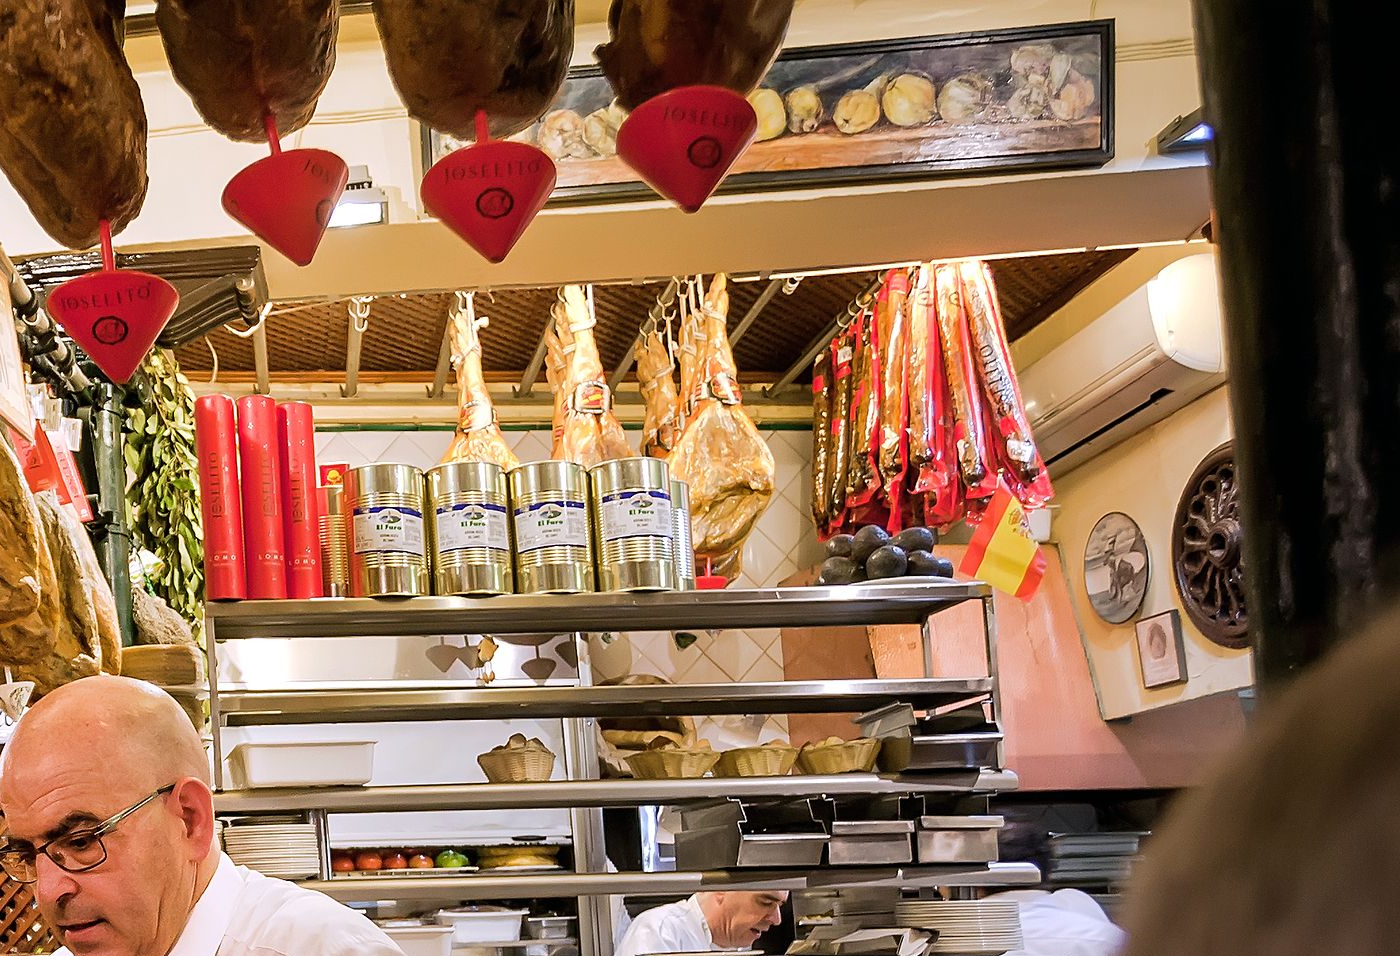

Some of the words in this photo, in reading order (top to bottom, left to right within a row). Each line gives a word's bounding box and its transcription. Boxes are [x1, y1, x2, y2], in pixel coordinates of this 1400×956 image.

[444, 161, 541, 184] JOSELITO
[61, 285, 151, 312] JOSELITO
[208, 452, 223, 519] JOSELITO
[288, 558, 316, 566] LOMO
